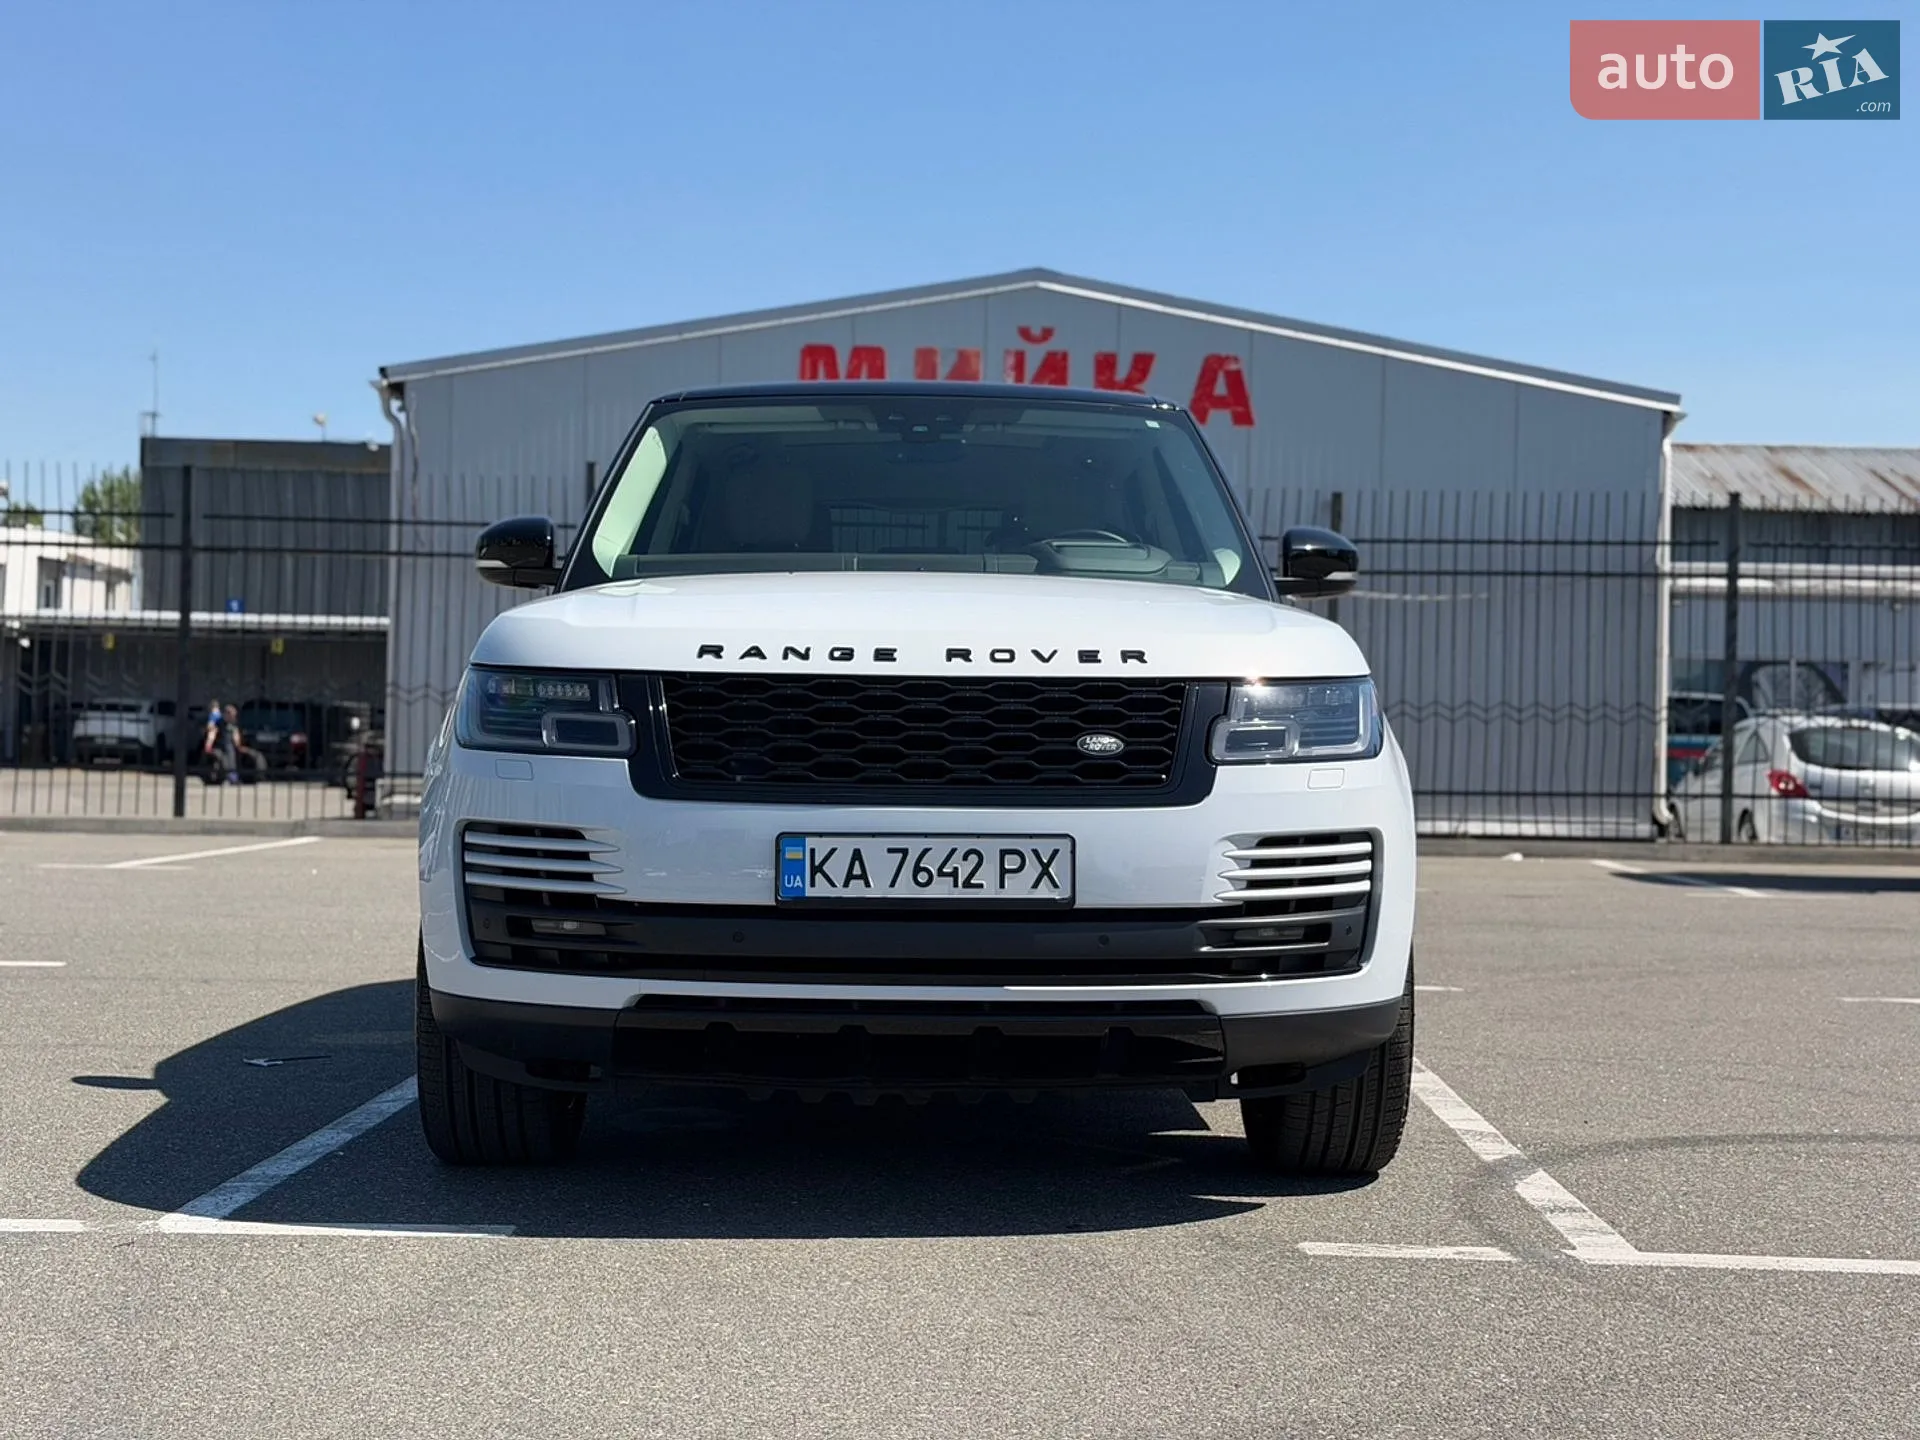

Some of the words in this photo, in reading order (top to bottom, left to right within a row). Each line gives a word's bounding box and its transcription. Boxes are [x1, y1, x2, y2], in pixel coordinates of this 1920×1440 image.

[697, 643, 898, 663] RANGE
[945, 647, 1148, 664] ROVER
[809, 847, 872, 889] KA
[886, 847, 985, 889] 7642
[999, 847, 1061, 890] PX
[784, 875, 803, 889] UA
